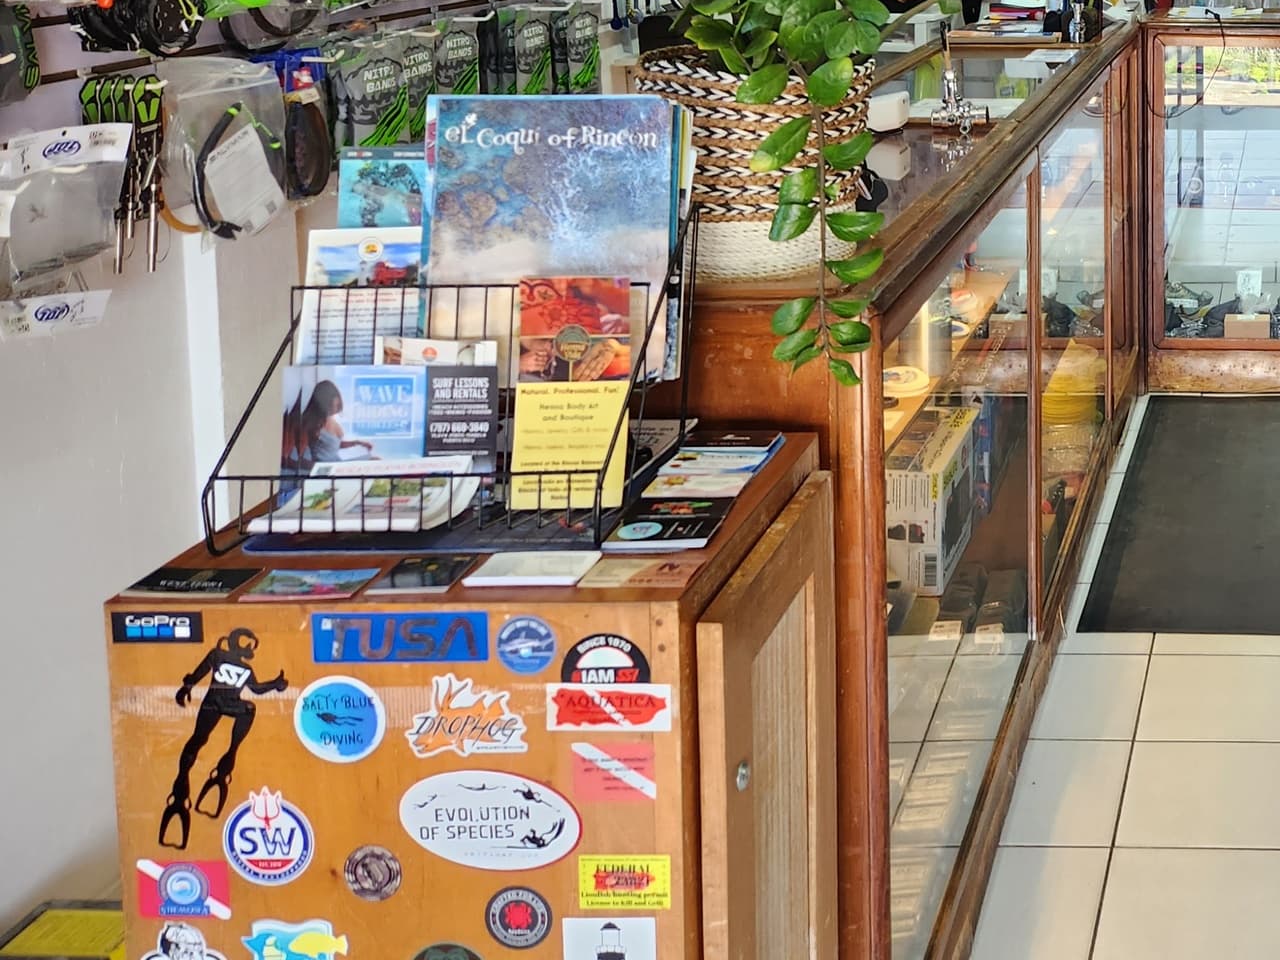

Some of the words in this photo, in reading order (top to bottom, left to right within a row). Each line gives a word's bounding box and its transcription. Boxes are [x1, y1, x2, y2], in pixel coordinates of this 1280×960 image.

[447, 46, 473, 60] BANDS
[366, 76, 397, 93] BANDS
[548, 126, 579, 149] of
[432, 377, 453, 388] SURF
[454, 377, 489, 388] LESSONS
[434, 388, 452, 399] AND
[453, 388, 488, 399] RENTALS
[125, 614, 190, 628] GoPro
[321, 617, 478, 660] TUSA
[214, 662, 251, 687] SSI
[302, 693, 340, 712] SALTY
[341, 693, 376, 711] BLUE
[565, 694, 656, 709] AQUATICA
[320, 730, 364, 746] DIVING
[435, 806, 531, 823] EVOLUTION
[419, 826, 440, 841] OF
[446, 823, 515, 840] SPECIES
[239, 826, 296, 856] SW
